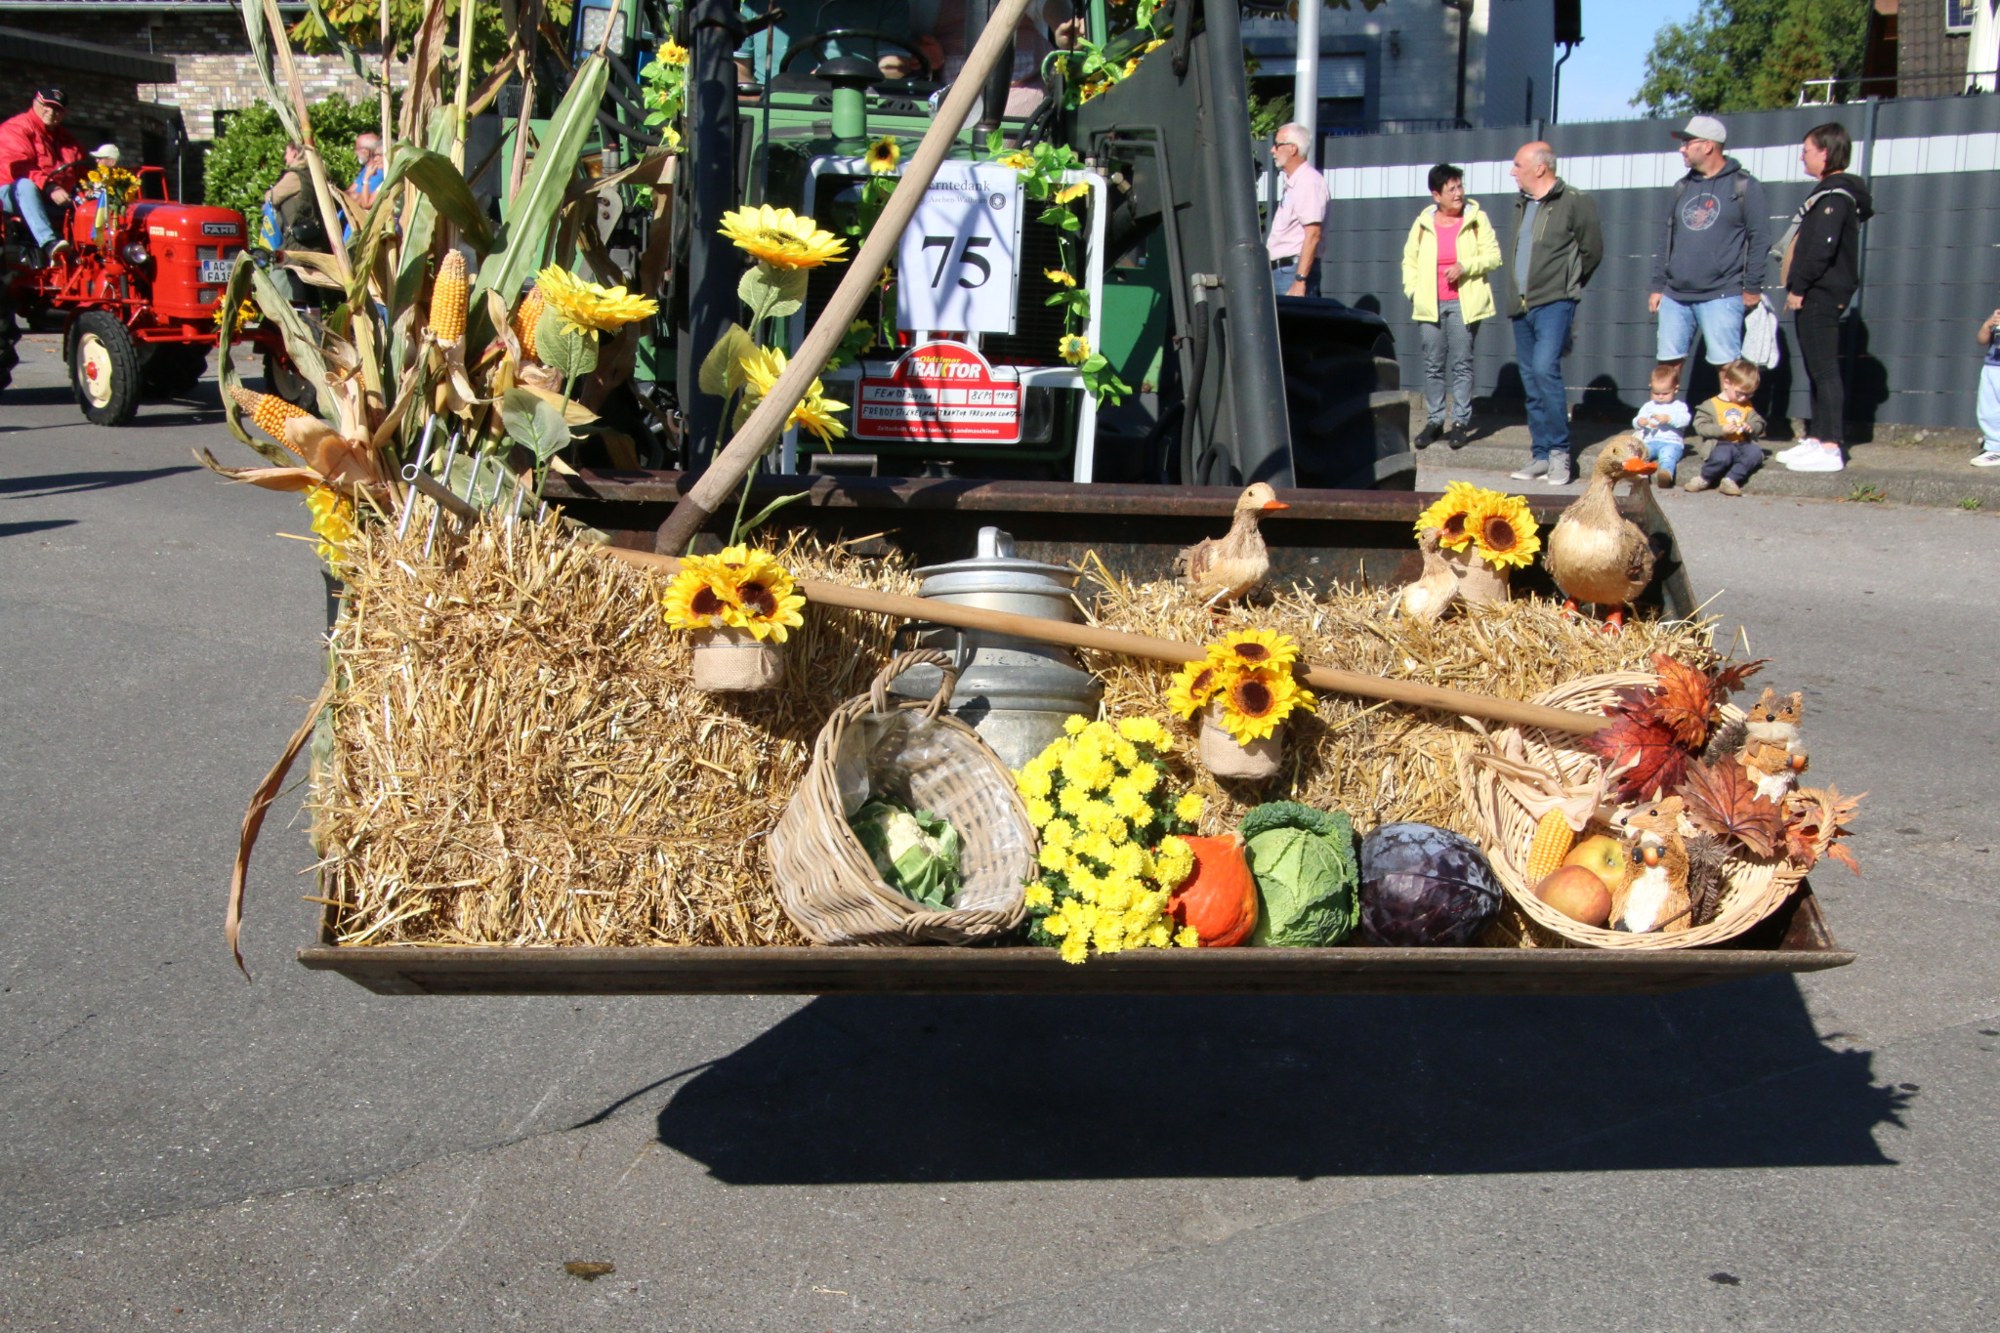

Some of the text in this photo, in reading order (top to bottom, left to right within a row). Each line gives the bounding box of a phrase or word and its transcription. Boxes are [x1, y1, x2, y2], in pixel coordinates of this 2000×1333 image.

[205, 225, 236, 233] FAHR
[214, 262, 225, 270] AC
[921, 235, 992, 289] 75
[920, 355, 961, 363] Oldtimer
[906, 357, 982, 379] TRAKTOR
[874, 388, 906, 398] FENDT
[996, 391, 1016, 399] 1985
[863, 406, 894, 416] FREDDY
[876, 424, 999, 435] Zeitschrift für historische Landmaschinen
